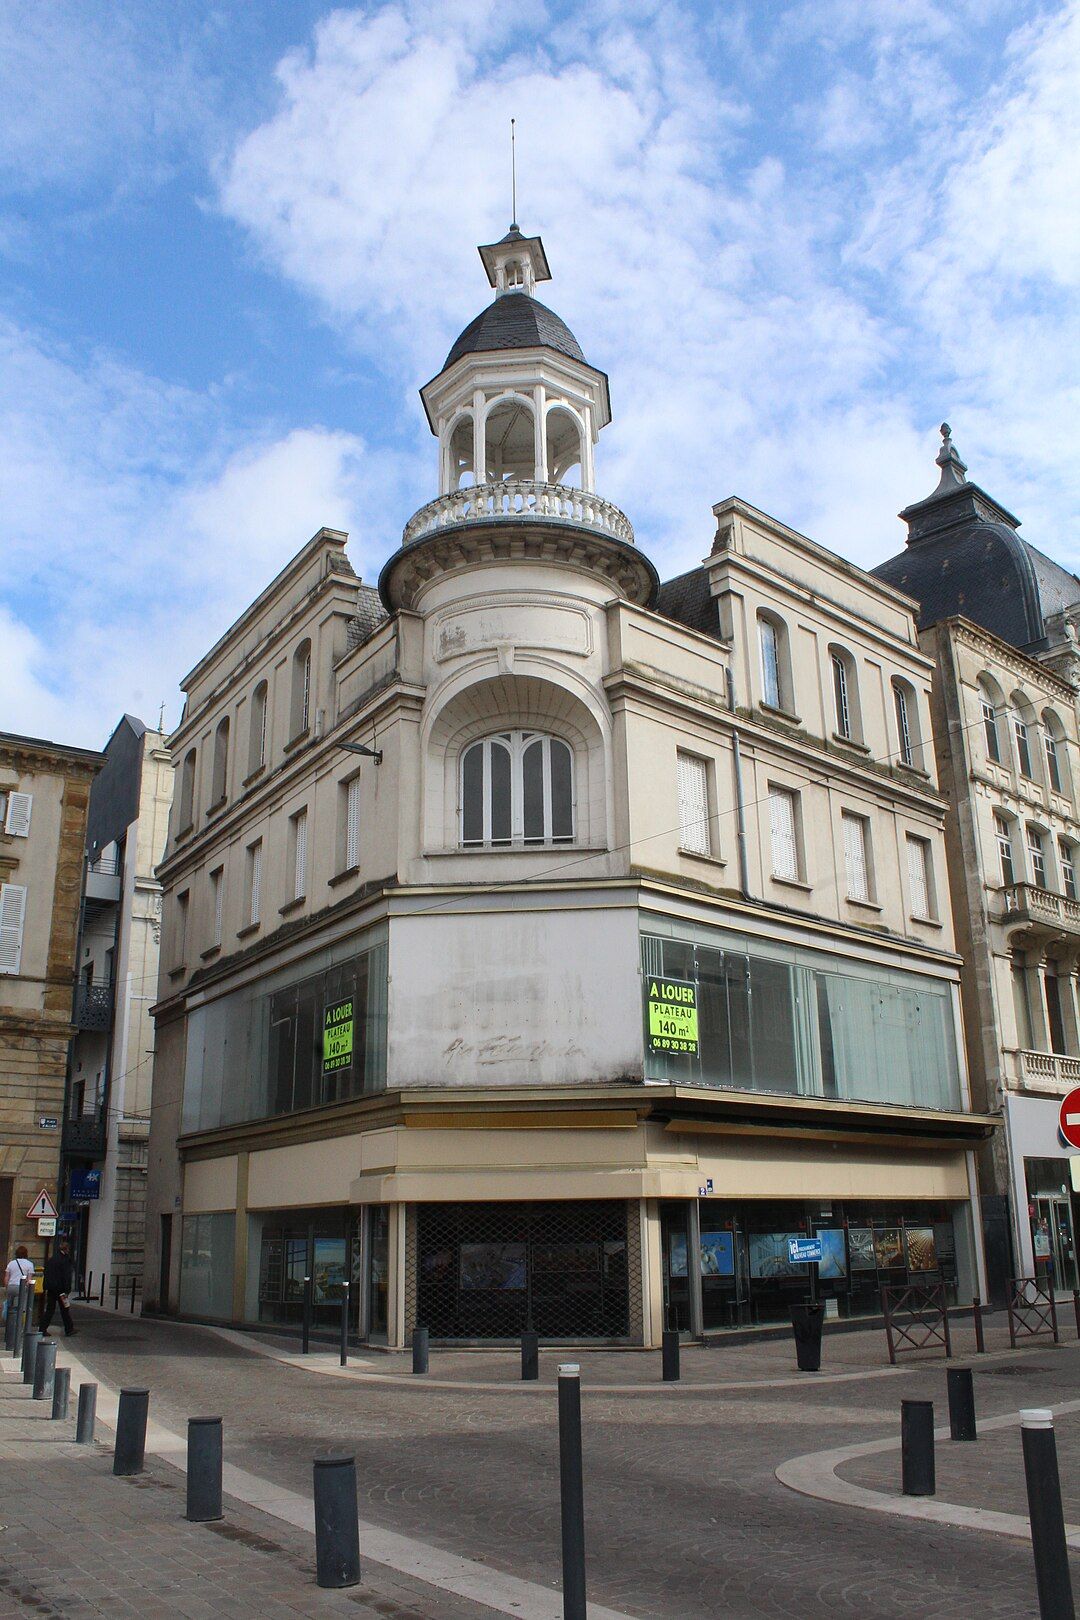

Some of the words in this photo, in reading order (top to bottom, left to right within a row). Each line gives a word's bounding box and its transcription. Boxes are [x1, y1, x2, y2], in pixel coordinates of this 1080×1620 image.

[650, 982, 659, 998] A
[661, 983, 695, 1004] LOUER
[326, 1010, 332, 1025] A
[332, 1002, 353, 1023] LOUER
[654, 1003, 692, 1019] PLATEAU
[327, 1023, 351, 1040] PLATEAU
[659, 1020, 677, 1035] 140
[329, 1041, 341, 1056] 140
[653, 1037, 661, 1048] 06
[661, 1038, 671, 1049] 89
[671, 1040, 680, 1050] 30
[688, 1042, 697, 1052] 28
[700, 1187, 706, 1195] 2
